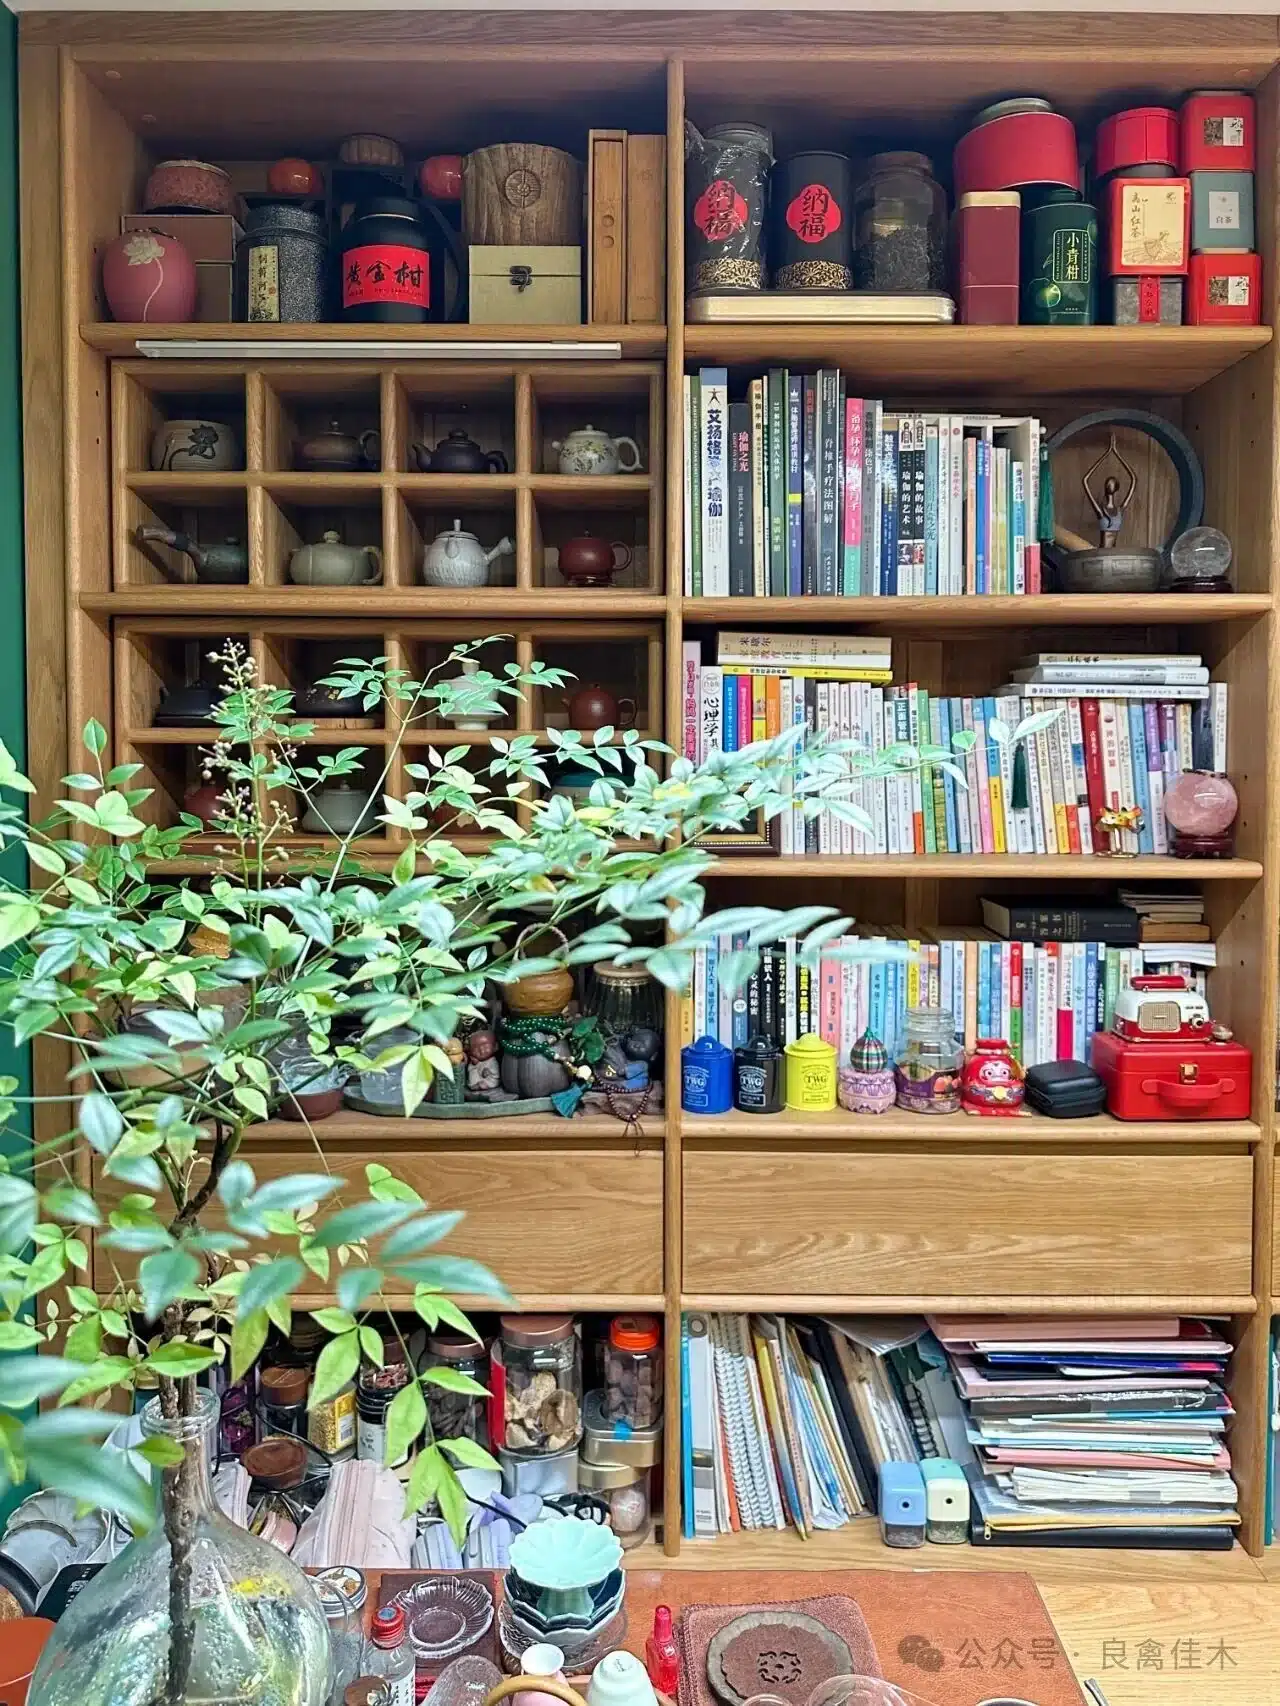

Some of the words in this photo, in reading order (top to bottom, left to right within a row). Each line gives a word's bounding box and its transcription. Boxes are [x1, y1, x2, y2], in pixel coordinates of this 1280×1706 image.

[704, 183, 735, 236] 纳福
[798, 188, 829, 238] 纳福
[346, 259, 425, 289] 黄金柑
[1065, 232, 1080, 280] 小青柑
[738, 431, 749, 472] 瑜伽之光
[902, 470, 911, 525] 瑜伽的艺术
[915, 470, 924, 525] 瑜伽的故事
[703, 697, 720, 737] 心理学
[897, 702, 908, 740] 正面管教
[685, 1076, 706, 1086] TWG
[741, 1075, 762, 1086] TWG
[806, 1075, 827, 1085] TWG
